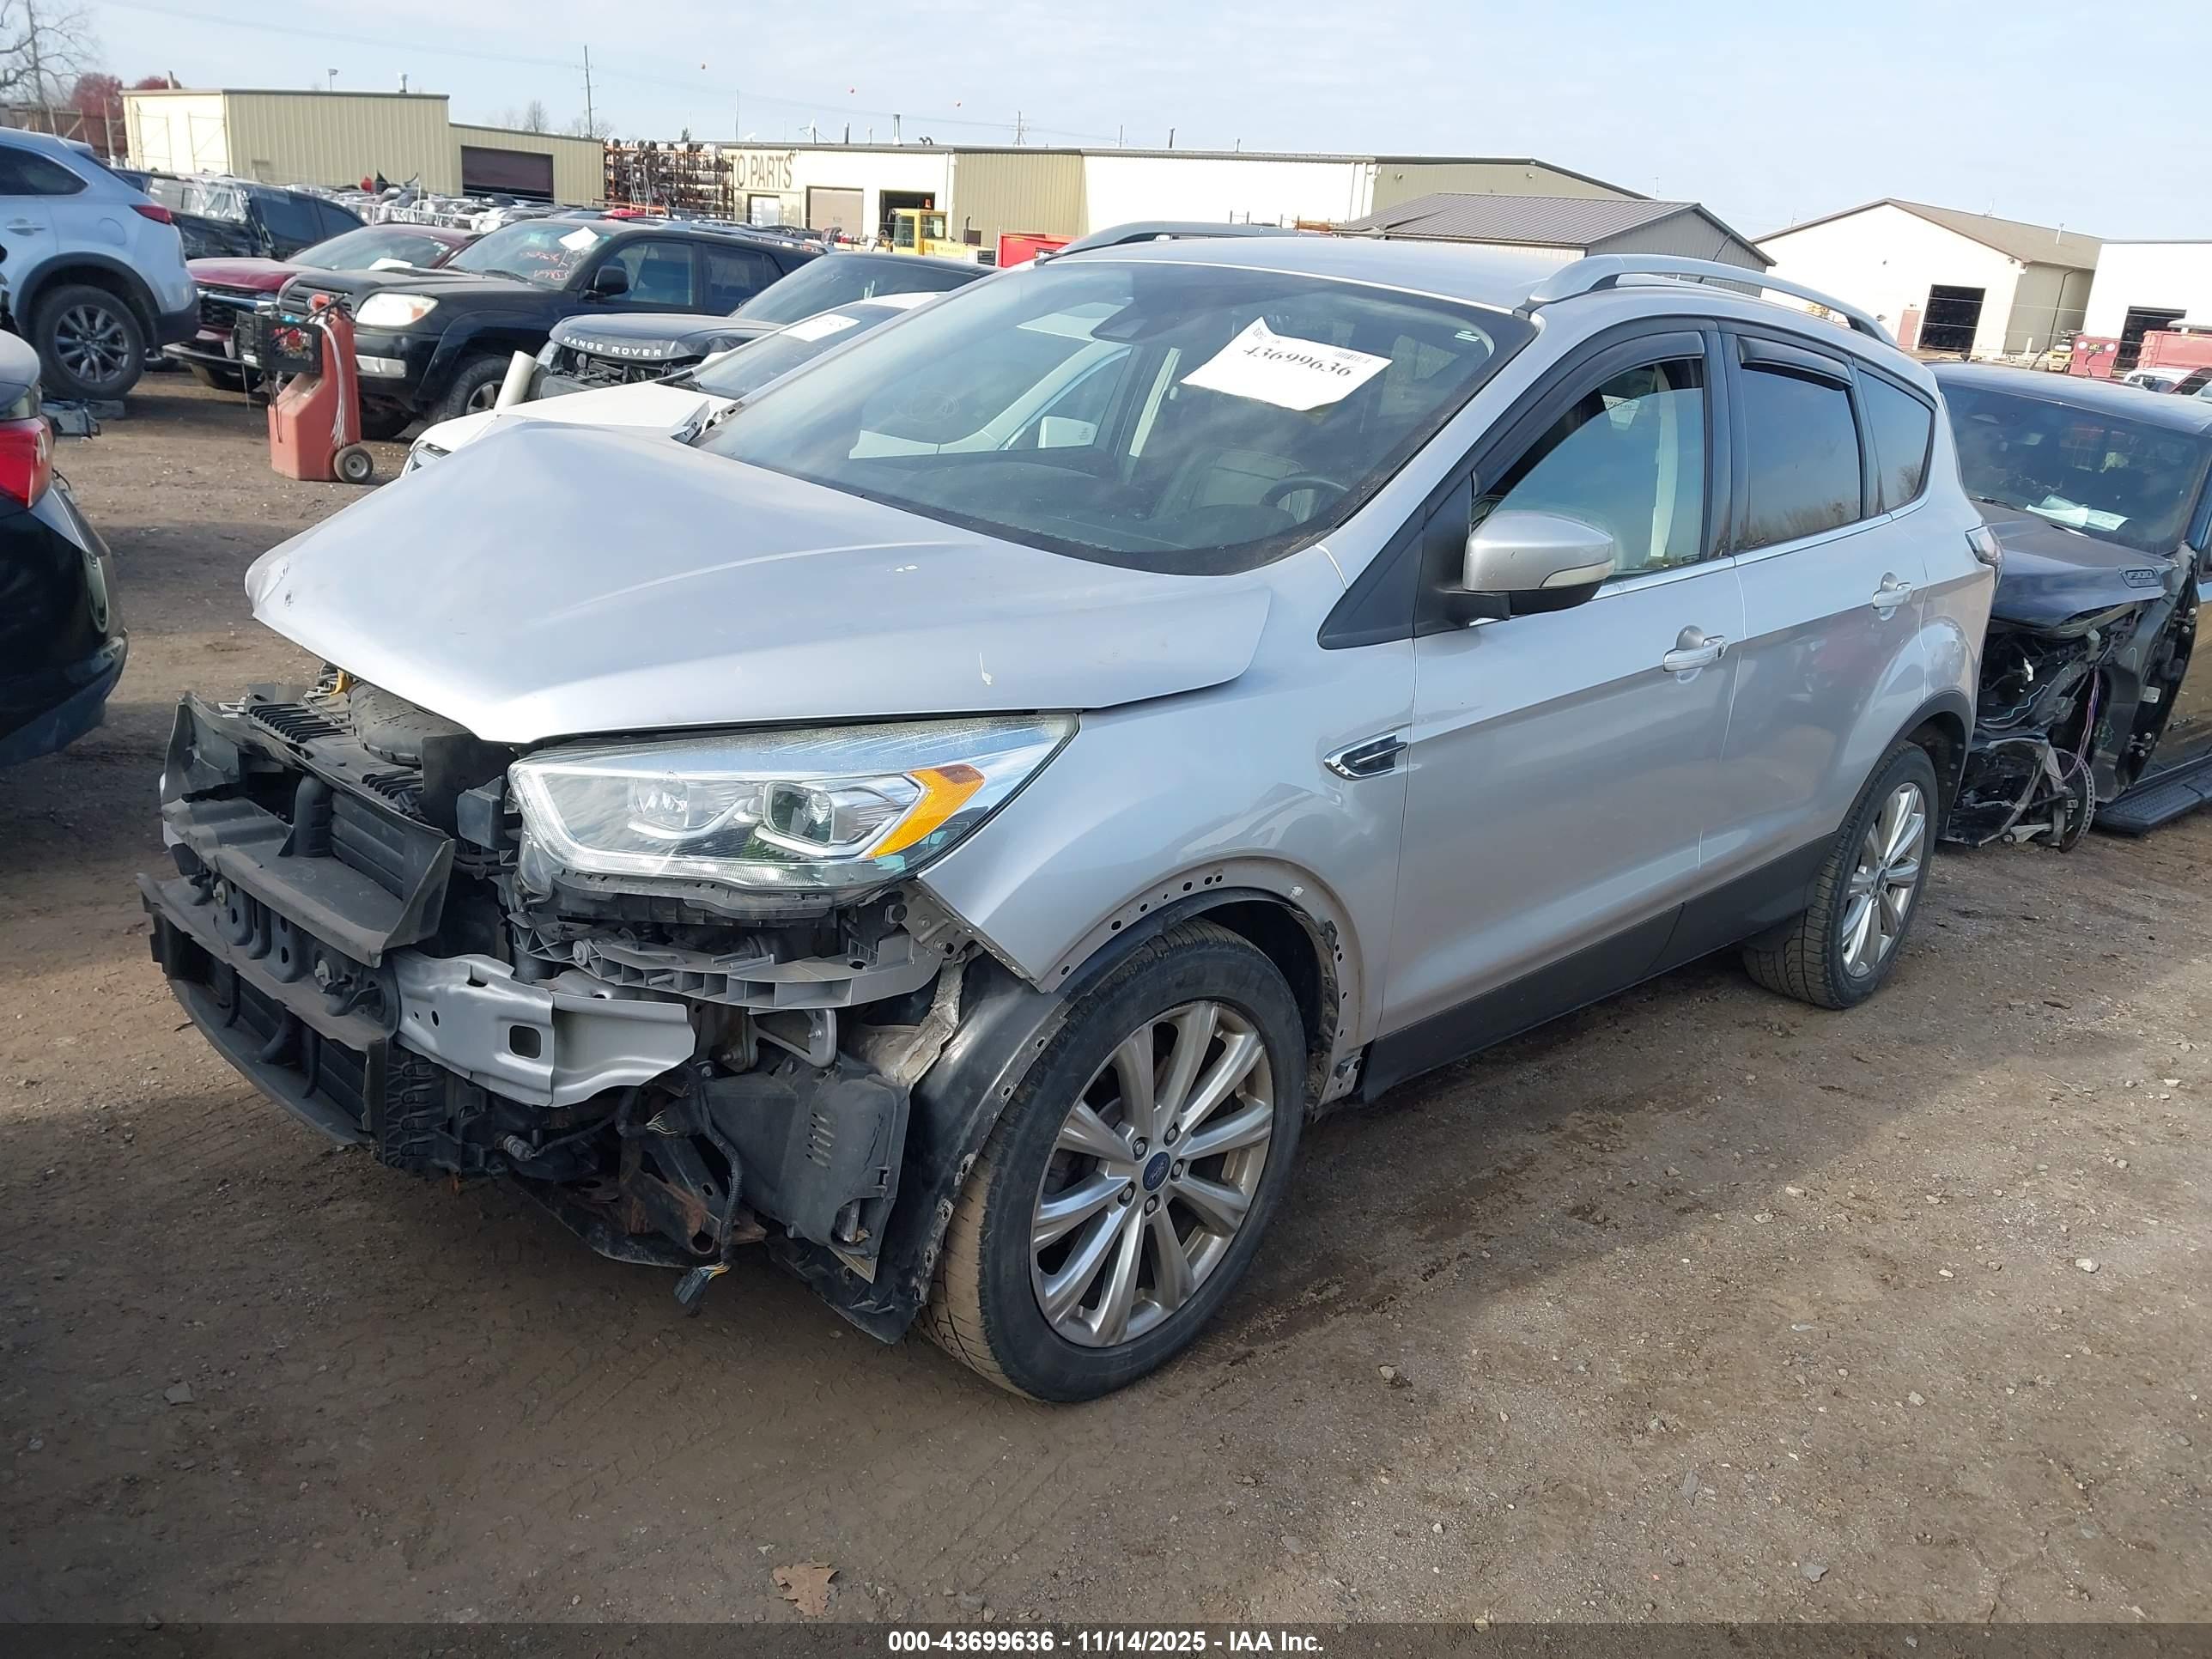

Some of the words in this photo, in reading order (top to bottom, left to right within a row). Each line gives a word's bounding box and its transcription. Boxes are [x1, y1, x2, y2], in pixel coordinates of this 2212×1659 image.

[726, 155, 745, 187] TO
[750, 155, 793, 188] PARTS
[563, 336, 604, 351] RANGE
[611, 346, 662, 357] ROVER
[1243, 346, 1354, 377] 43699636
